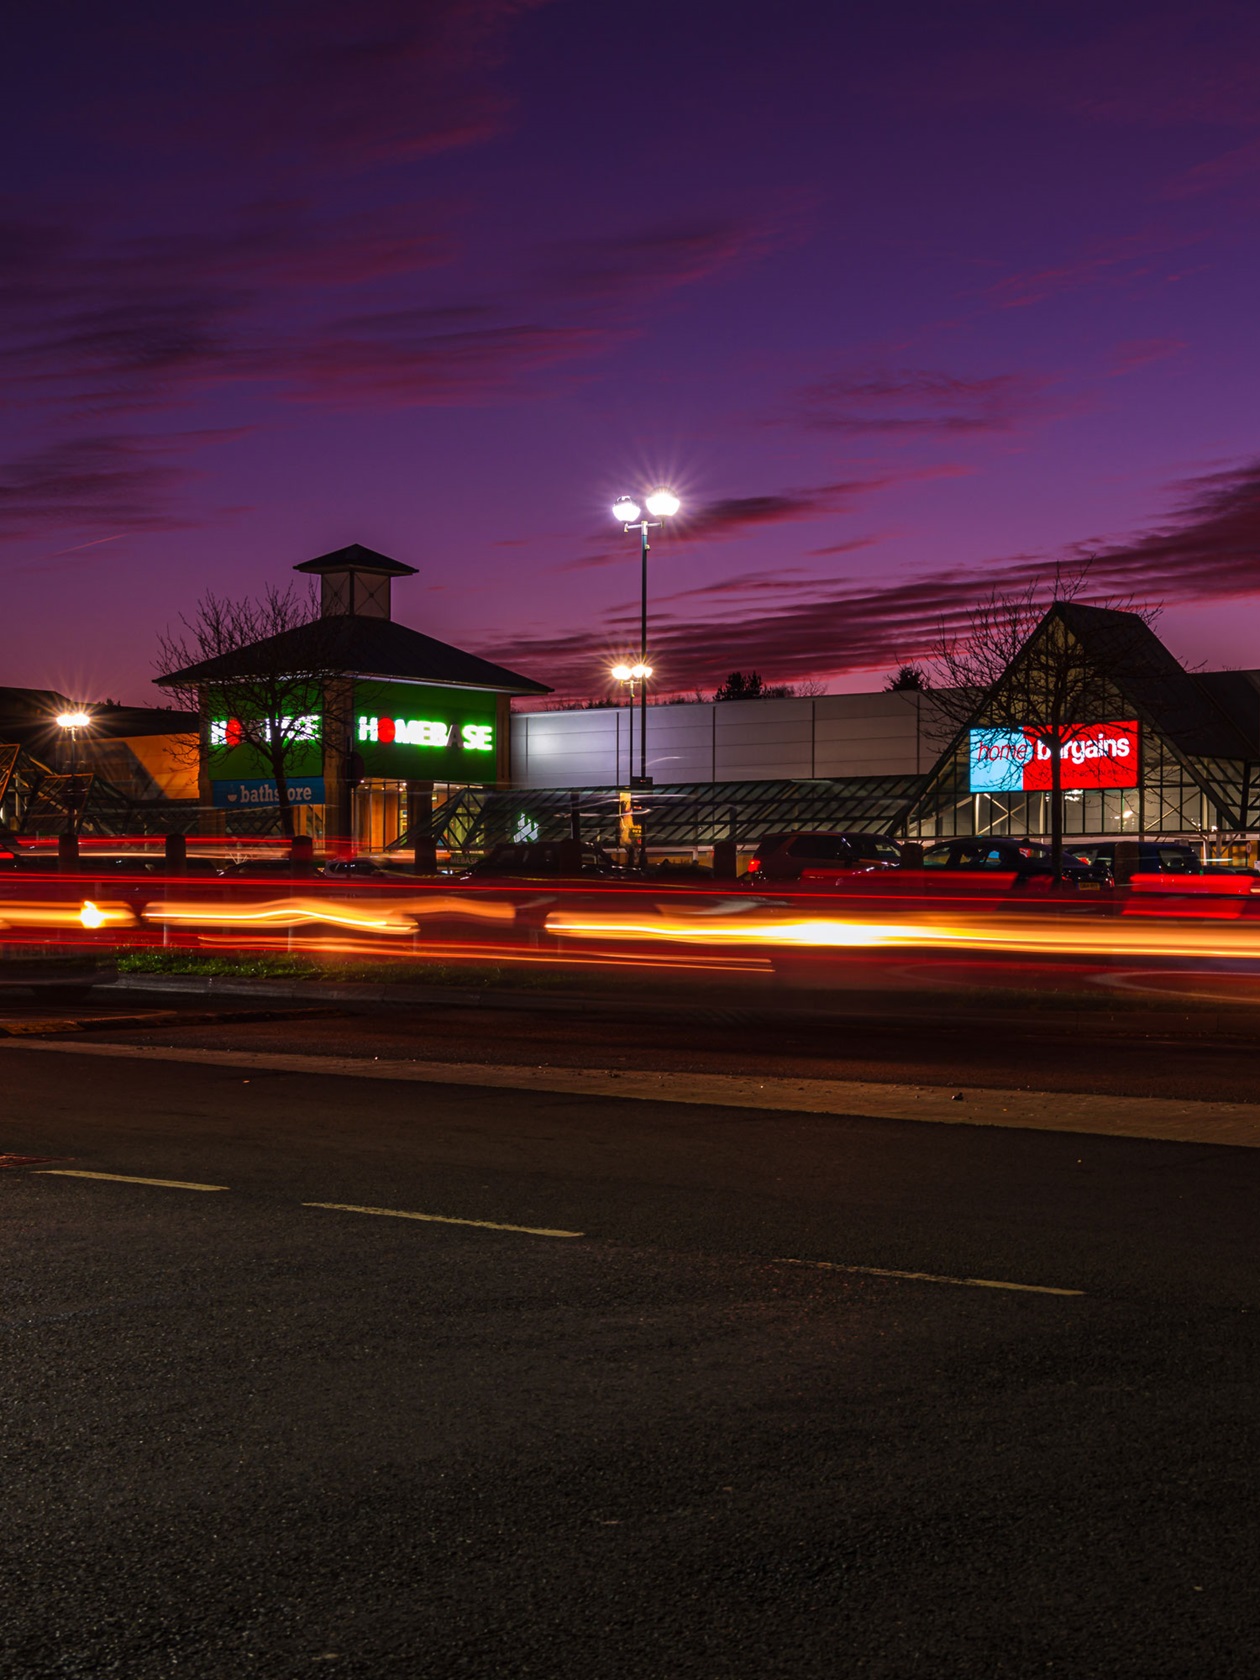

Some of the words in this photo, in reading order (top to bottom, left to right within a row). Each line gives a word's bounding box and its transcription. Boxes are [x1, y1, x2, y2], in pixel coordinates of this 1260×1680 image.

[358, 716, 493, 750] HOMEBASE
[977, 741, 1028, 761] home
[1037, 734, 1130, 764] brgains
[240, 784, 312, 803] bathsore
